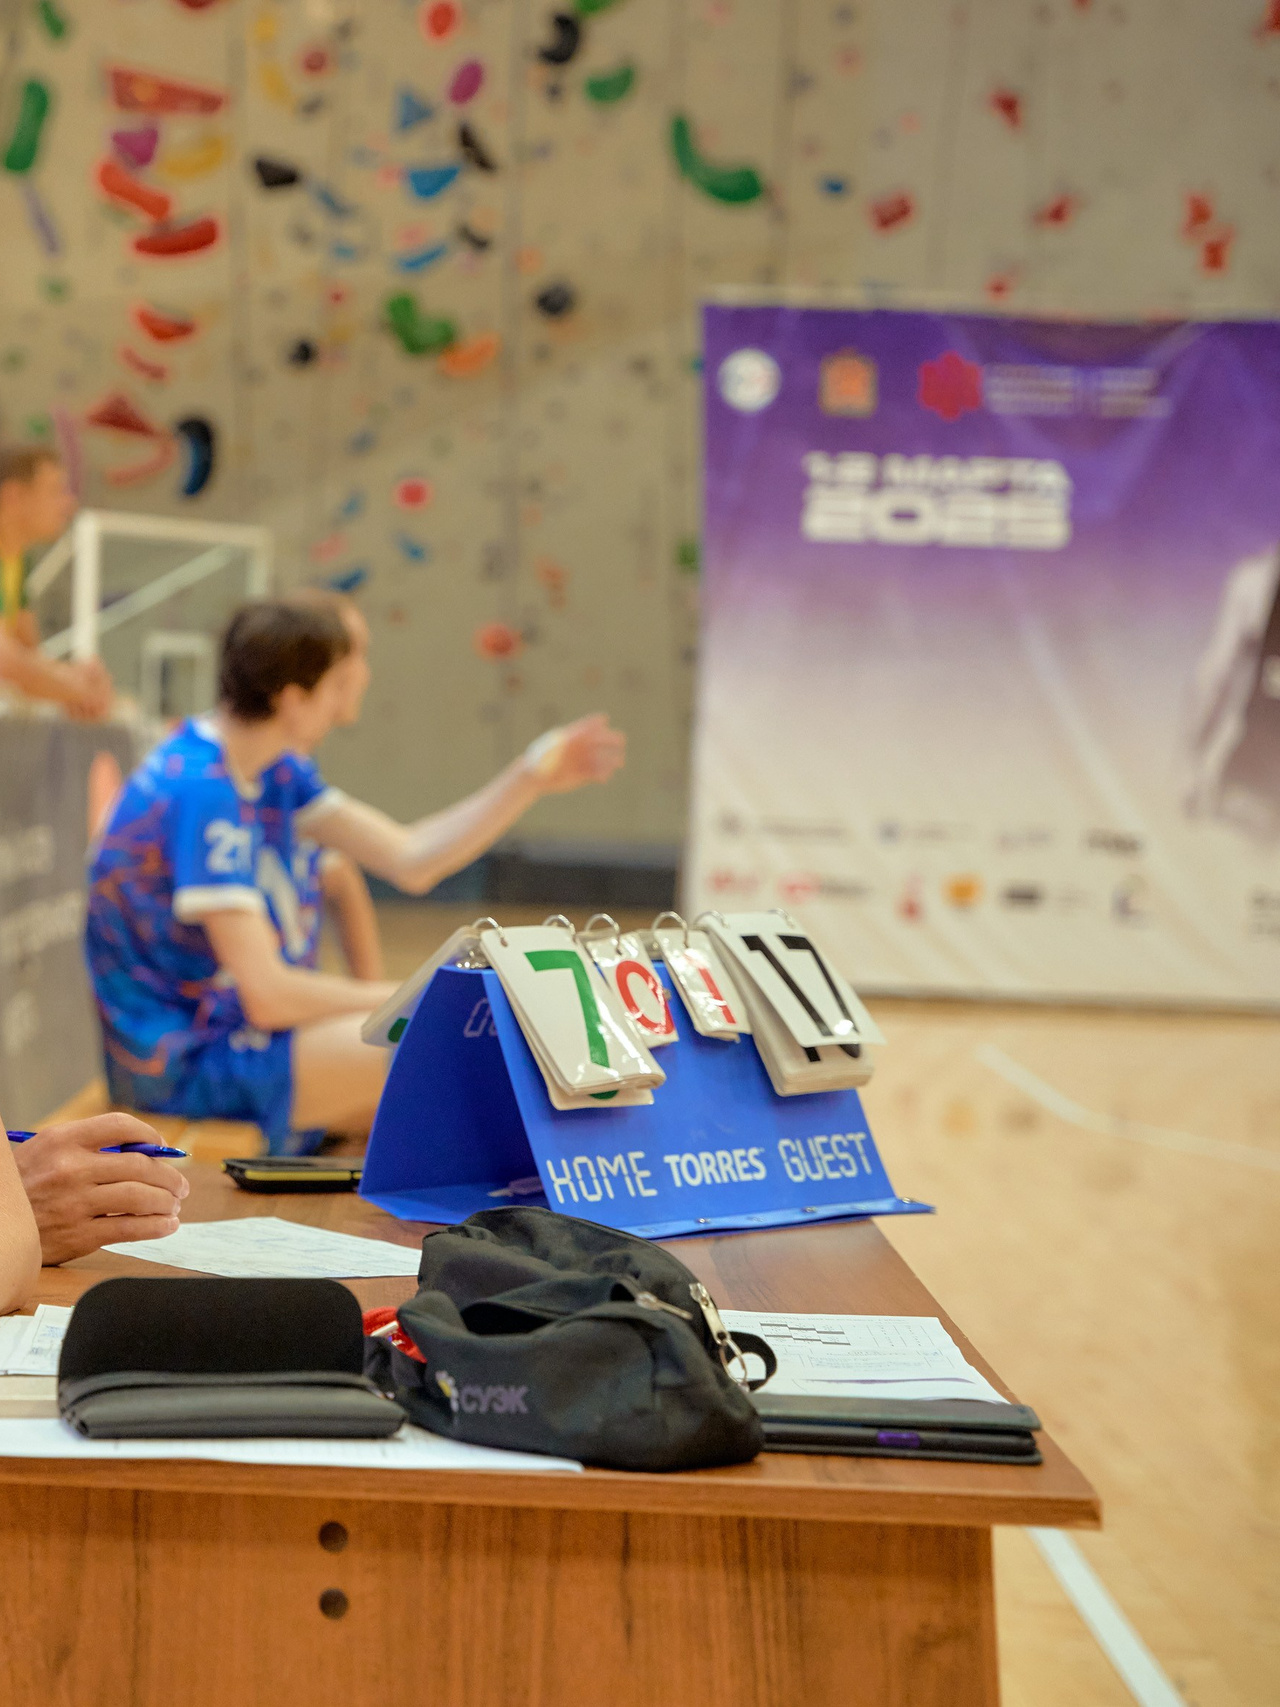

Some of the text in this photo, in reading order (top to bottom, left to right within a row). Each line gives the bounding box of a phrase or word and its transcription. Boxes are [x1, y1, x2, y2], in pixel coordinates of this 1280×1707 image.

[204, 817, 252, 873] 21
[524, 949, 610, 1069] 7
[615, 960, 675, 1034] 0
[739, 934, 860, 1037] 17
[546, 1132, 873, 1204] HOME TORRES GUEST
[460, 1385, 528, 1414] СУЭК
